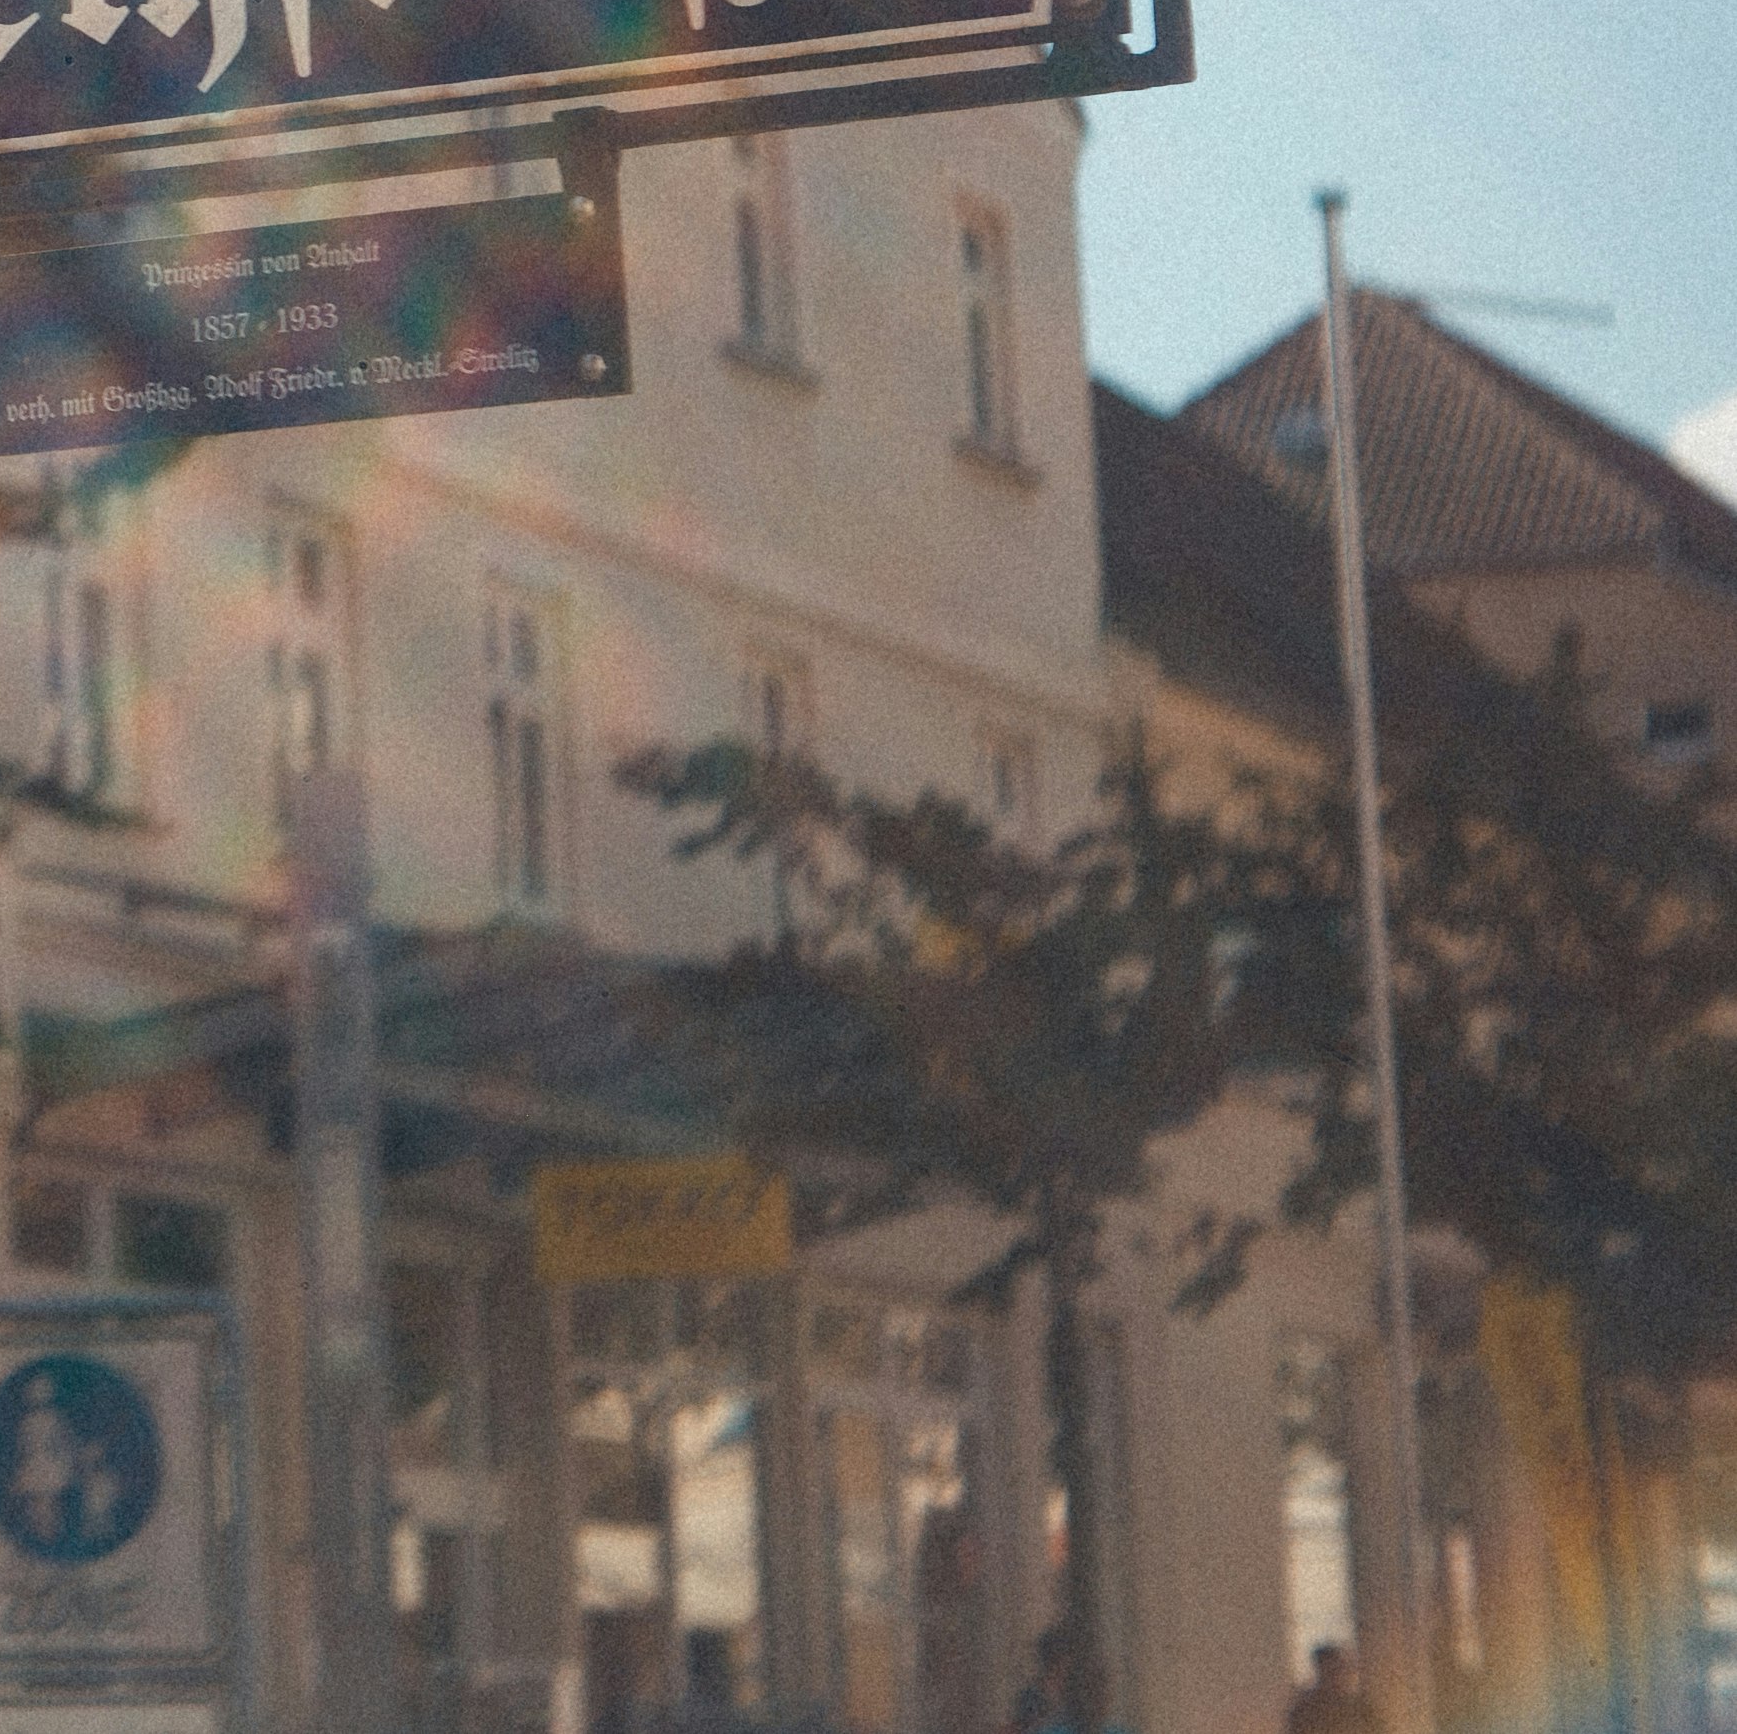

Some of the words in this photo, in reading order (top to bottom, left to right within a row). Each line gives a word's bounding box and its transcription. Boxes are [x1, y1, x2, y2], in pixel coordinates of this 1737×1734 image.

[141, 252, 256, 293] Prinzessin
[261, 253, 301, 275] von
[305, 239, 382, 271] Anhalt
[191, 311, 251, 343] 1857
[276, 302, 339, 334] 1933
[62, 389, 96, 418] mit
[204, 369, 265, 401] Adolf
[267, 364, 344, 400] Friedr.
